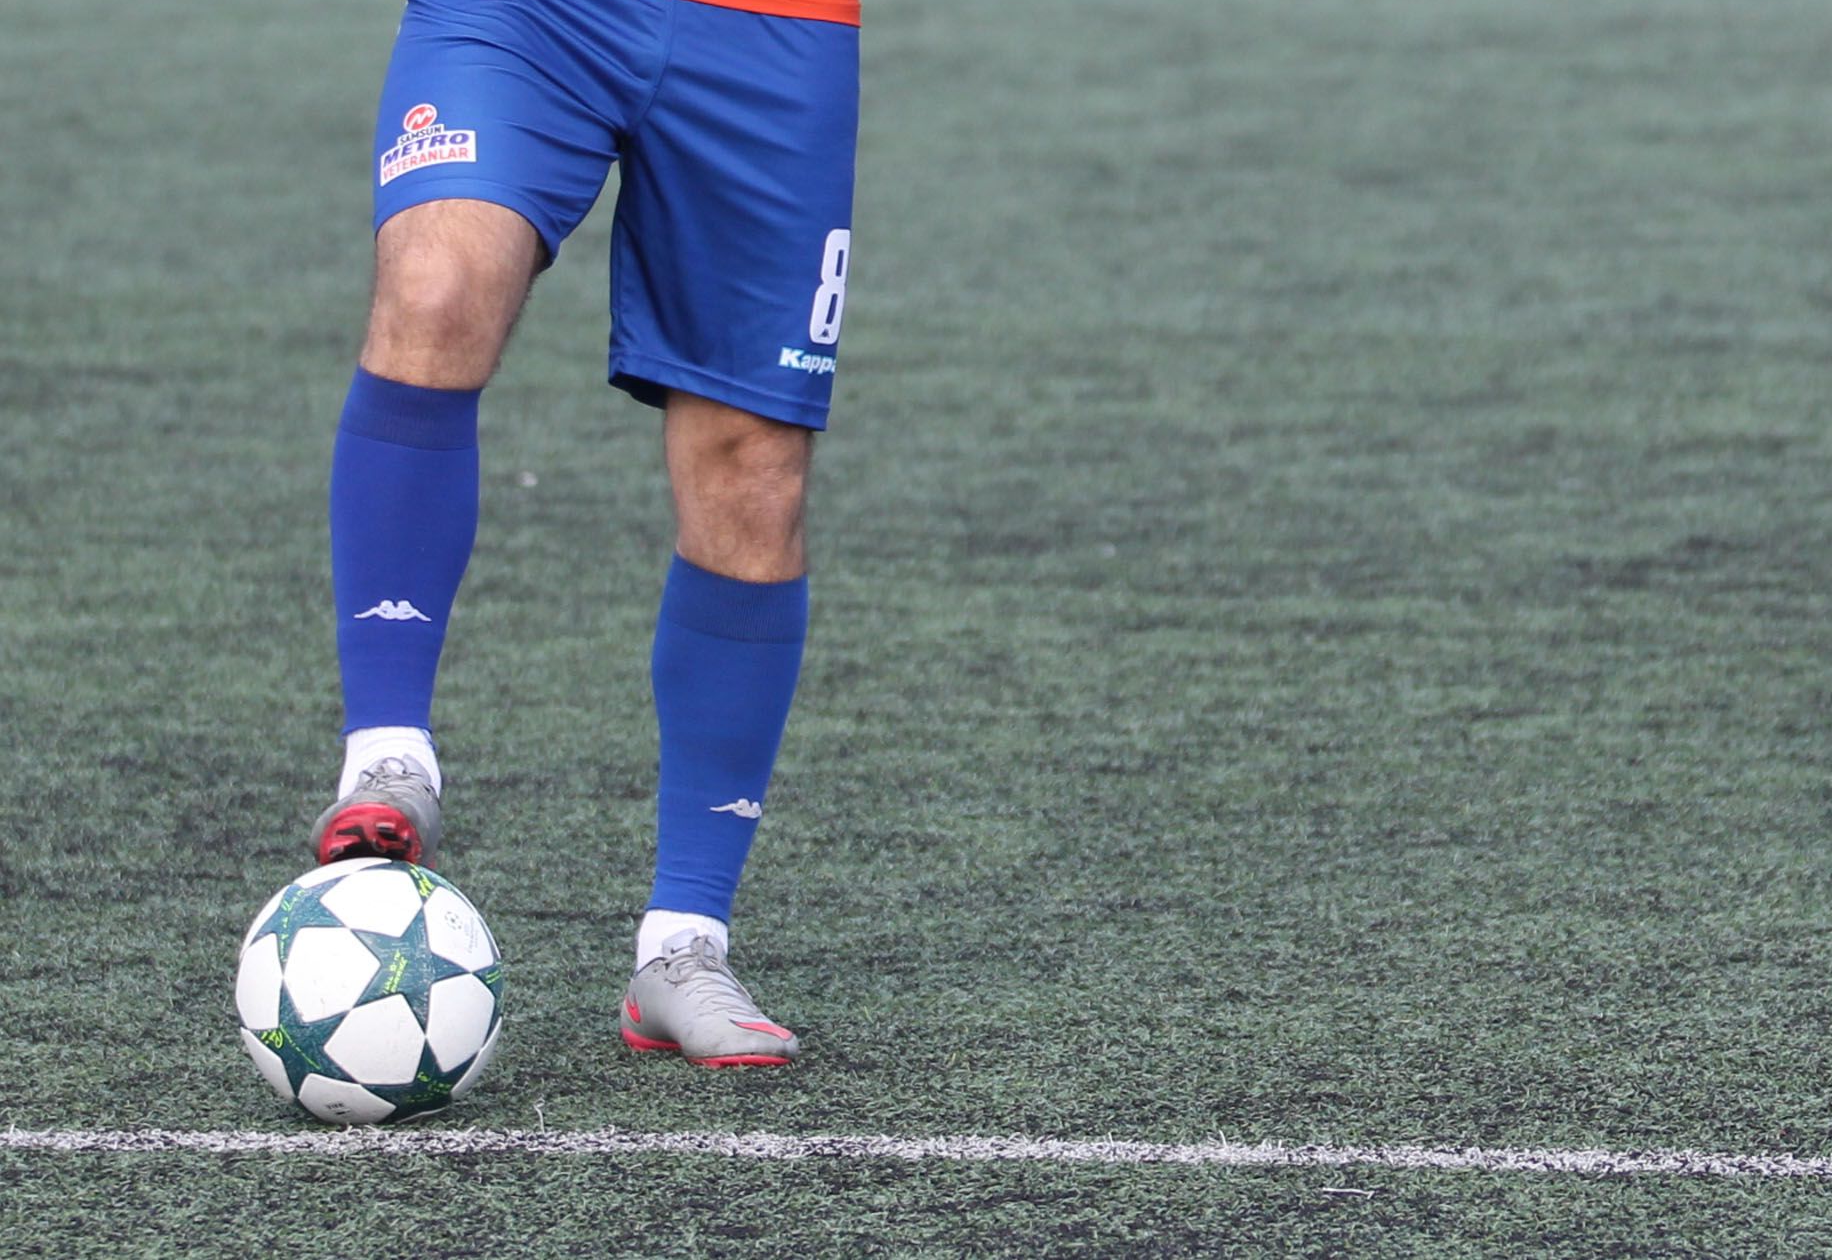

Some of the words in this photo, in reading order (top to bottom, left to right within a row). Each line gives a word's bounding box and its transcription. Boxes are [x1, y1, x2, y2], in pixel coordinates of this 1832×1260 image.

[382, 132, 470, 169] METRO
[399, 125, 443, 146] SAMSUN
[382, 146, 470, 181] VETERANLAR
[809, 228, 851, 346] 8
[778, 345, 837, 375] Kapp
